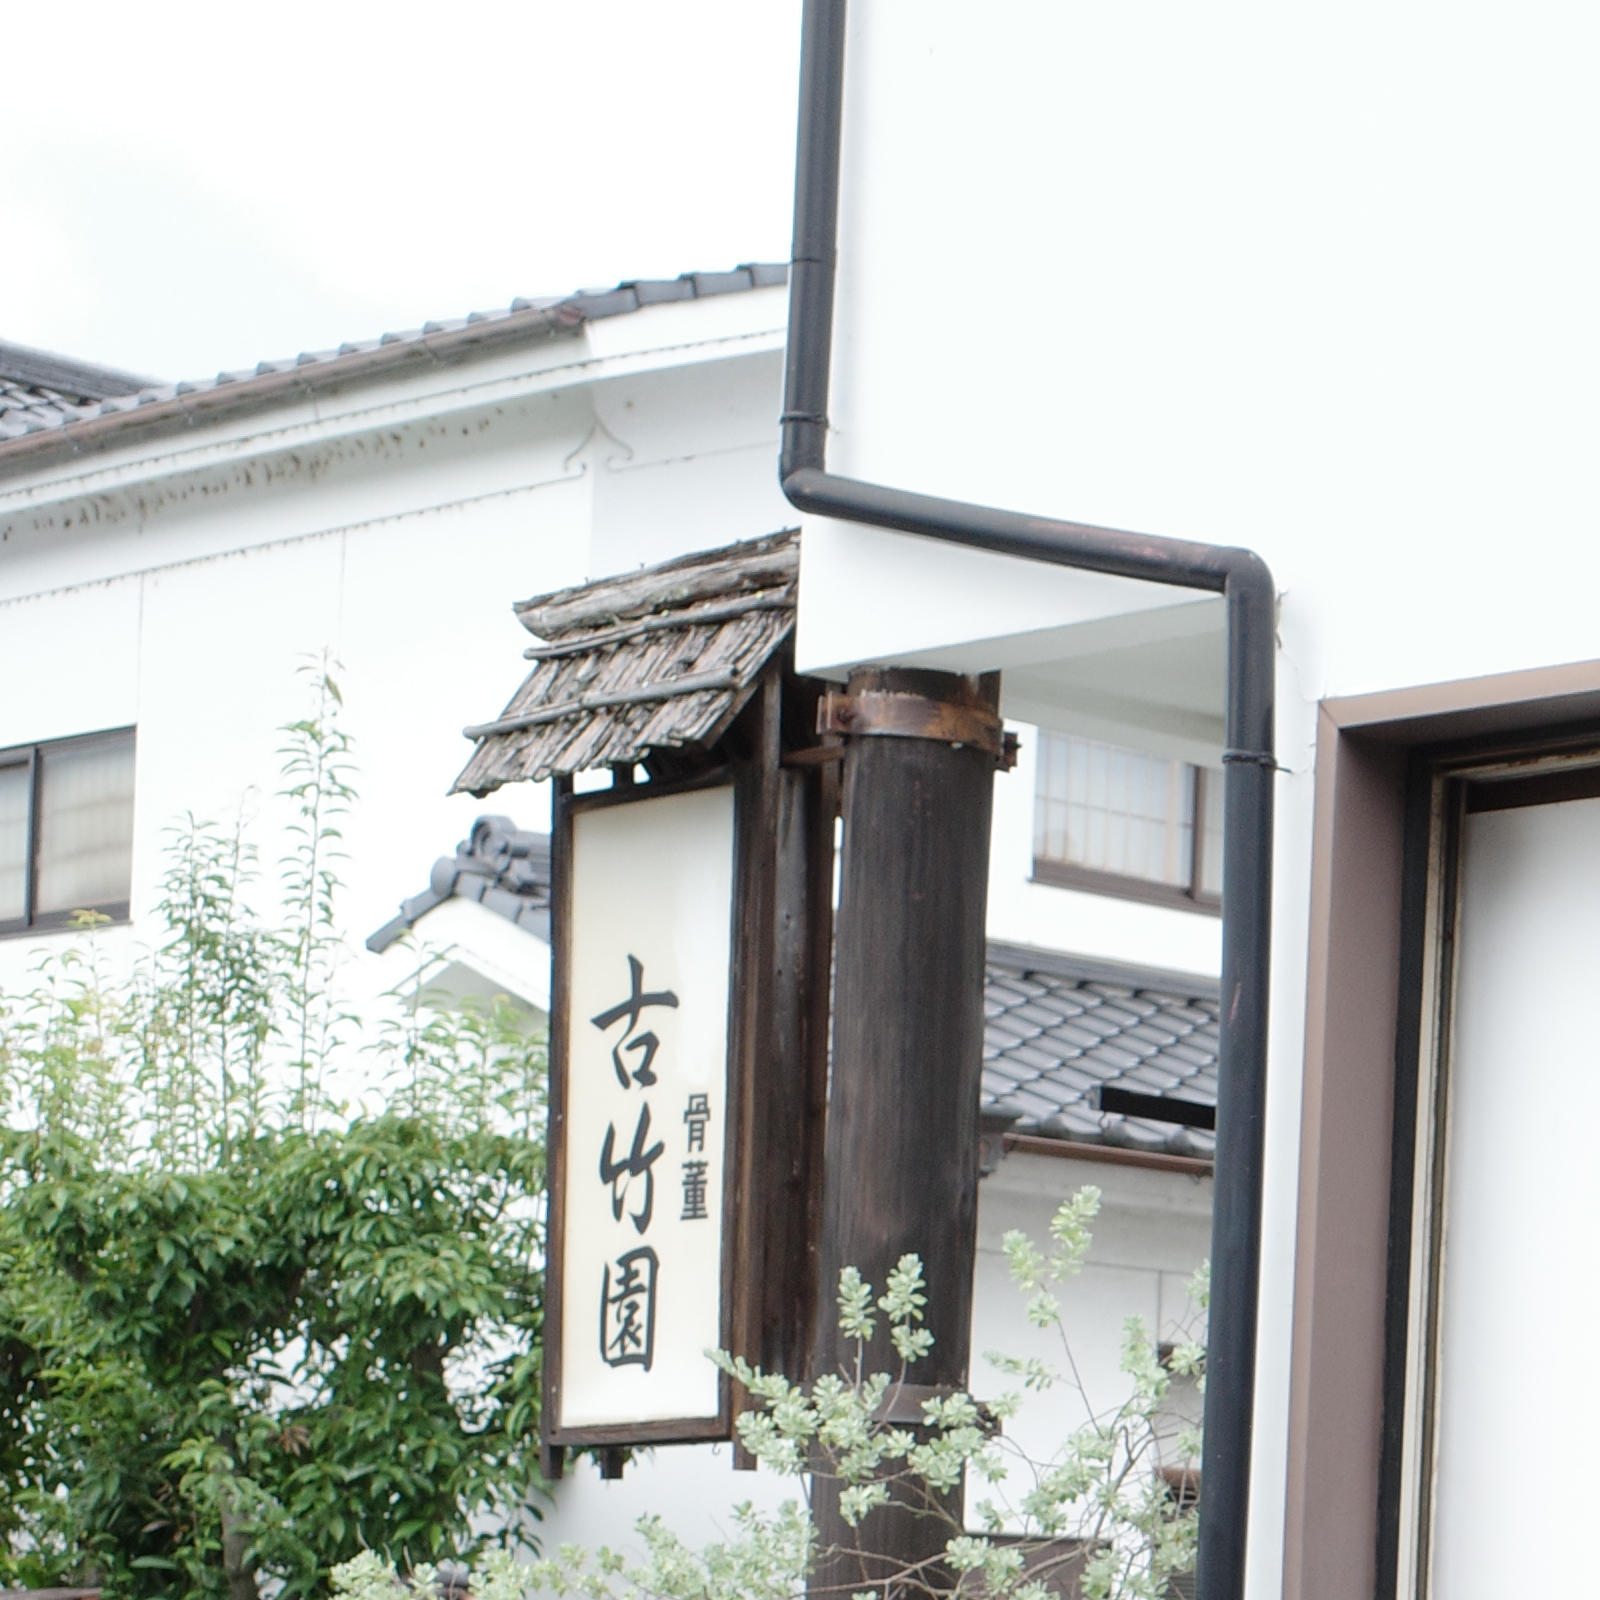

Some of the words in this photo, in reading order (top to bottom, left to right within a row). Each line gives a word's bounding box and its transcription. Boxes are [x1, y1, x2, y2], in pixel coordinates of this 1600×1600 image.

[590, 953, 680, 1372] 古竹園
[680, 1092, 711, 1221] 骨董
